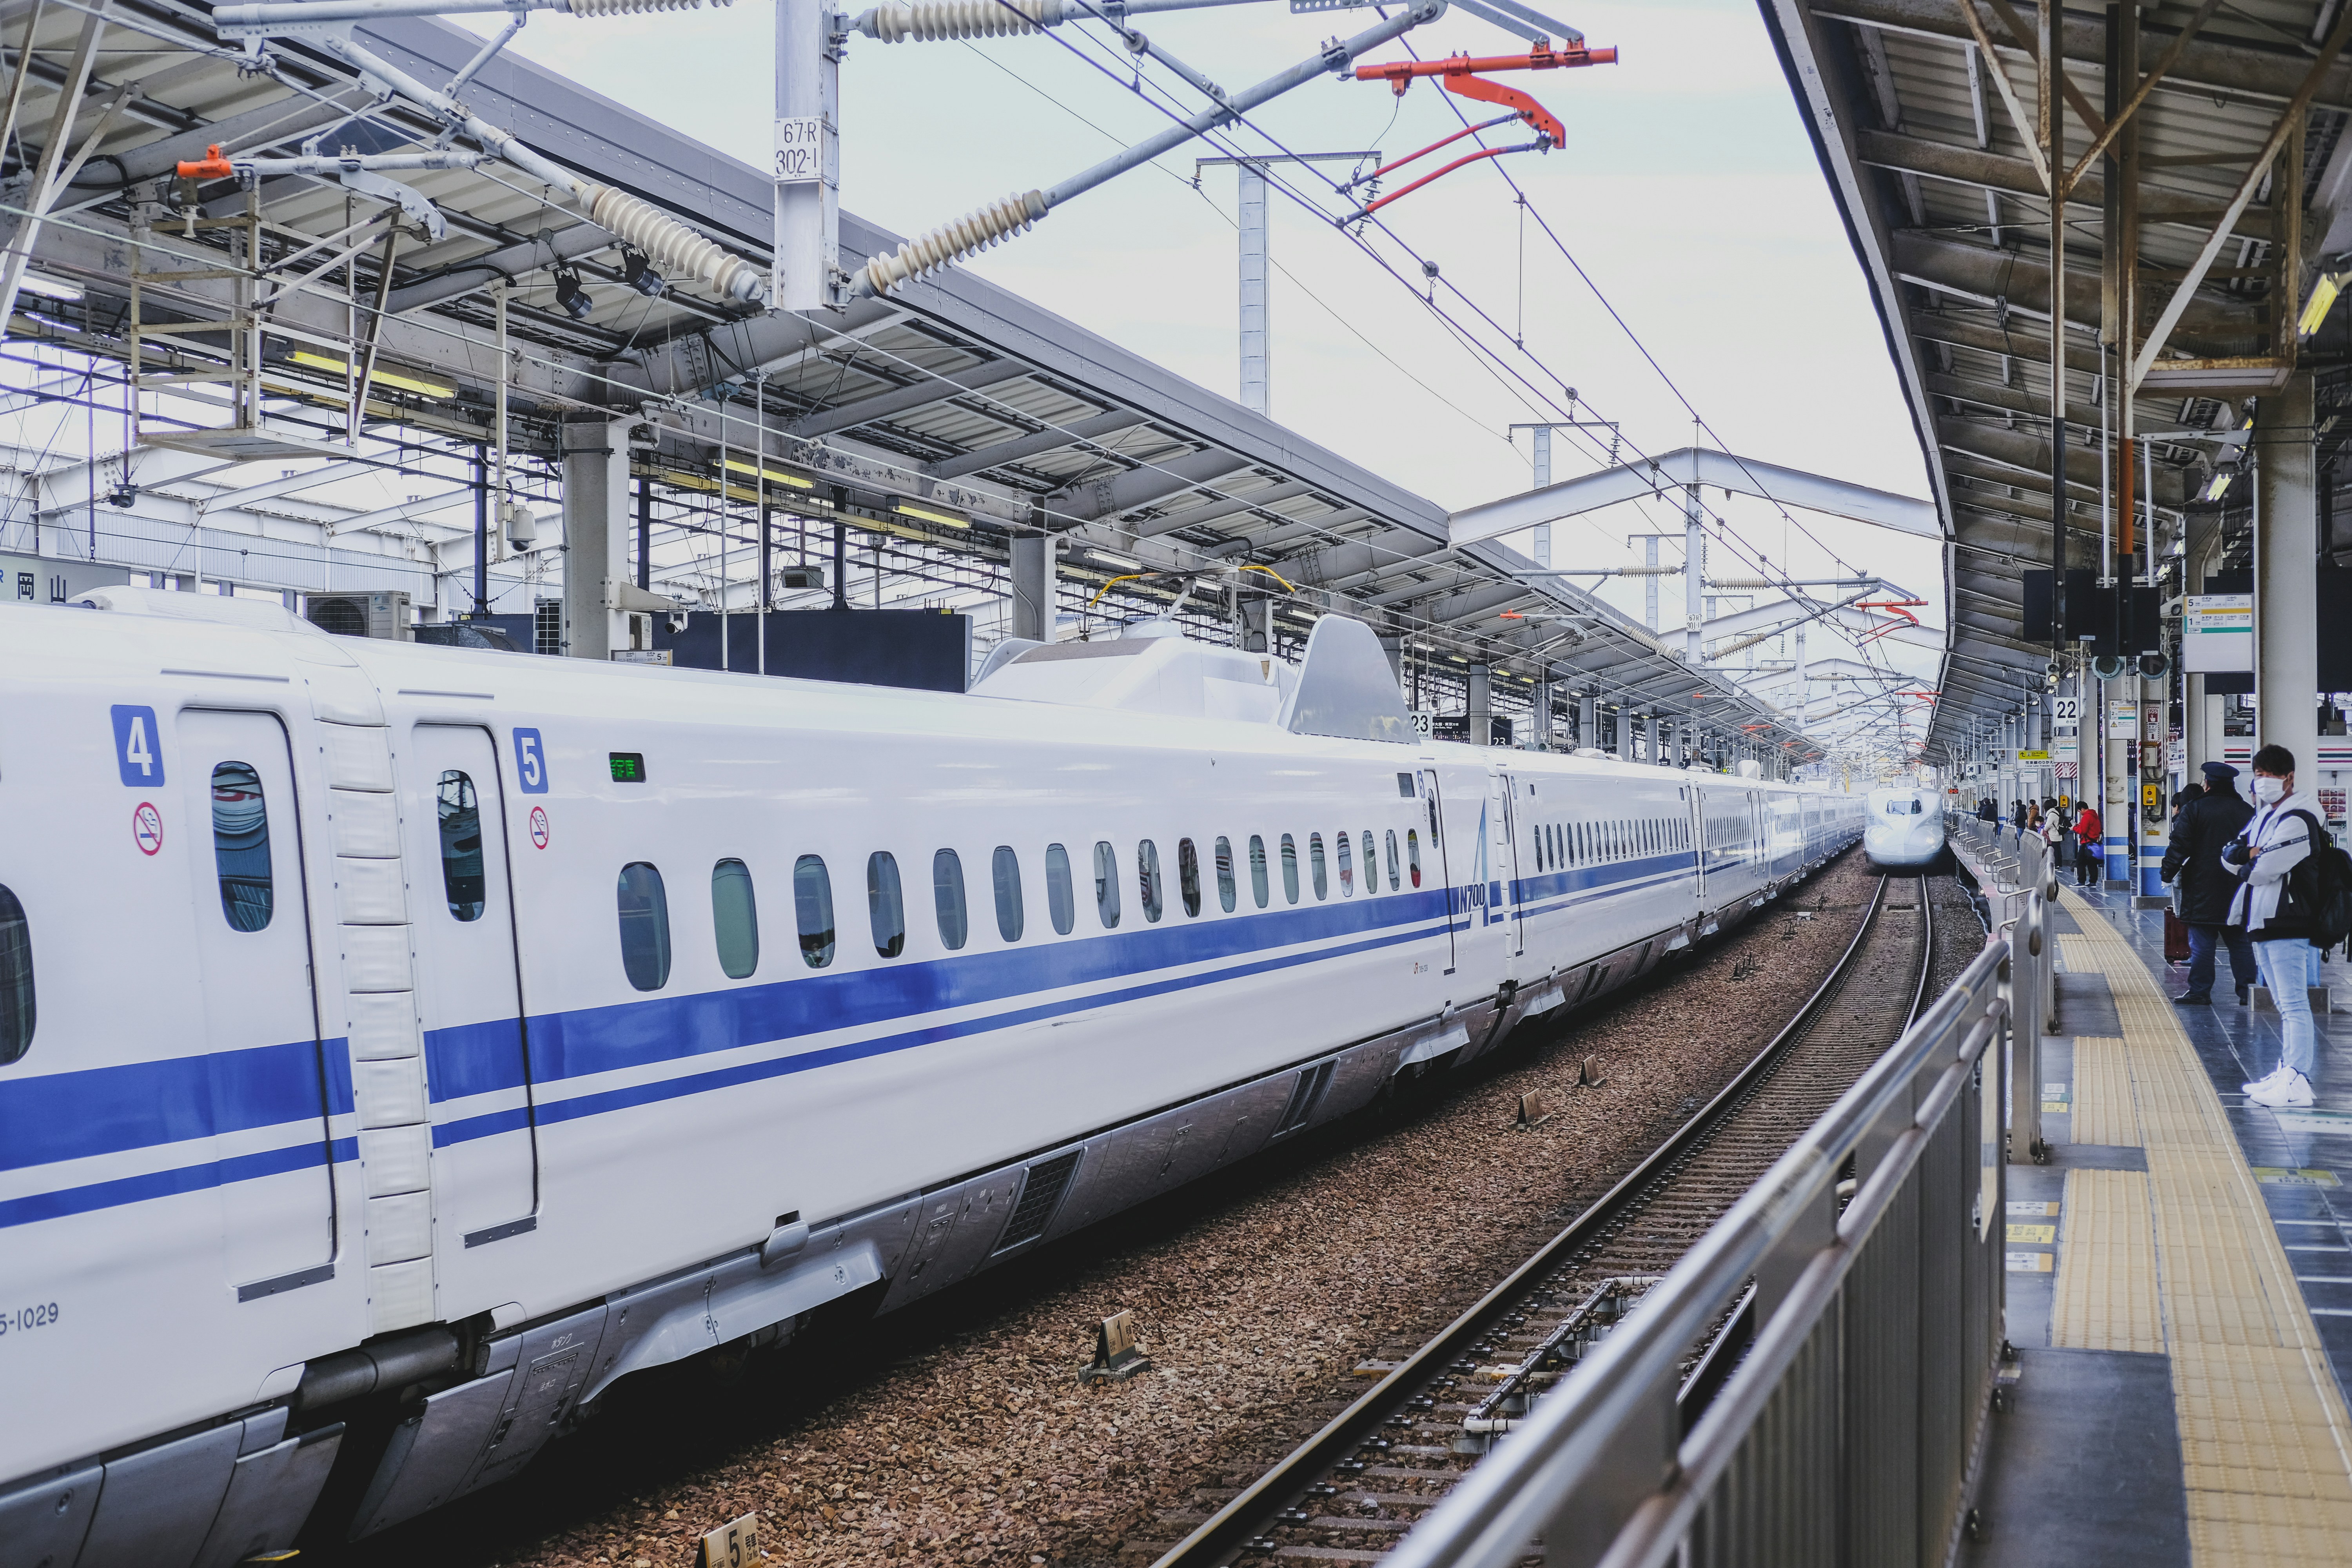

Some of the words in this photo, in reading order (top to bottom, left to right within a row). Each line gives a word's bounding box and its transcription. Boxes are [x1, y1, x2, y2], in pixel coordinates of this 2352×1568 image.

[18, 572, 66, 603] 岡山
[1411, 715, 1428, 732] 23
[2057, 701, 2076, 718] 22
[126, 717, 153, 776] 4
[521, 737, 540, 786] 5
[1418, 774, 1424, 796] 5
[1460, 883, 1485, 914] N700
[1116, 1319, 1123, 1347] 1
[728, 1528, 740, 1568] 5
